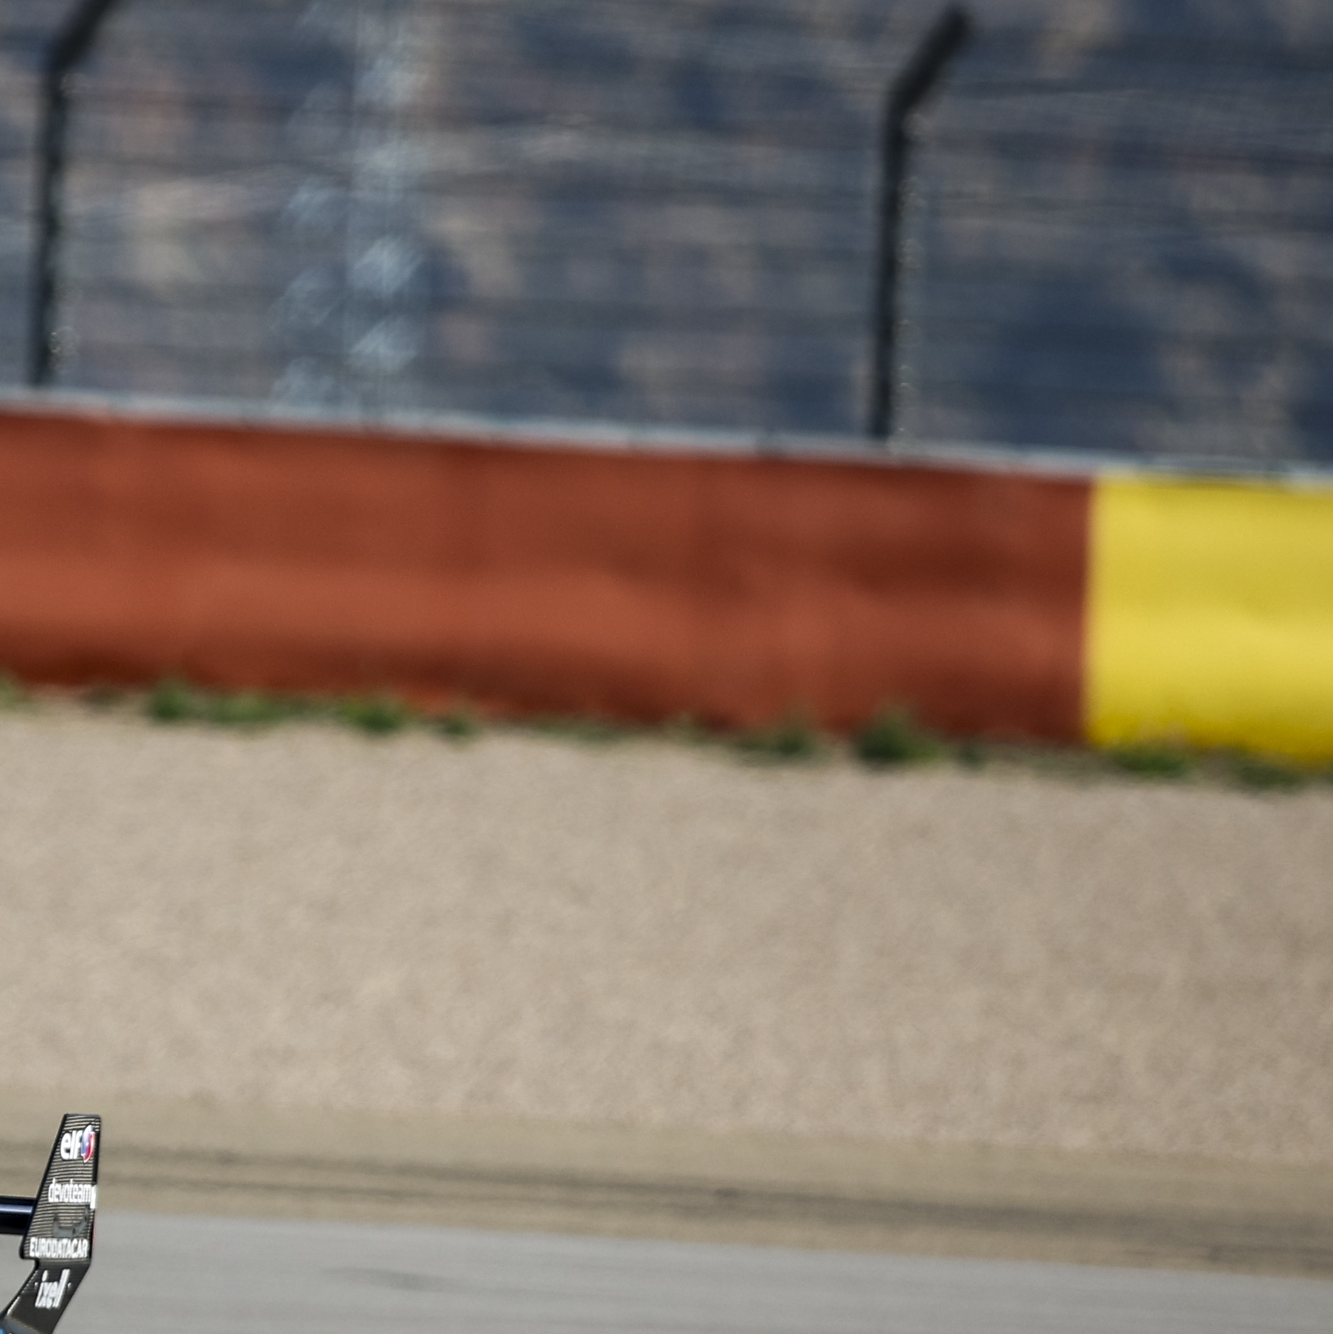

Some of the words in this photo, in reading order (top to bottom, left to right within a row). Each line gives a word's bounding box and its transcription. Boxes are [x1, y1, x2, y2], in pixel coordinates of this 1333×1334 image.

[60, 1130, 83, 1160] elf
[48, 1178, 96, 1204] devoteam
[29, 1237, 89, 1259] EURODATACAR
[35, 1269, 71, 1309] ixell
